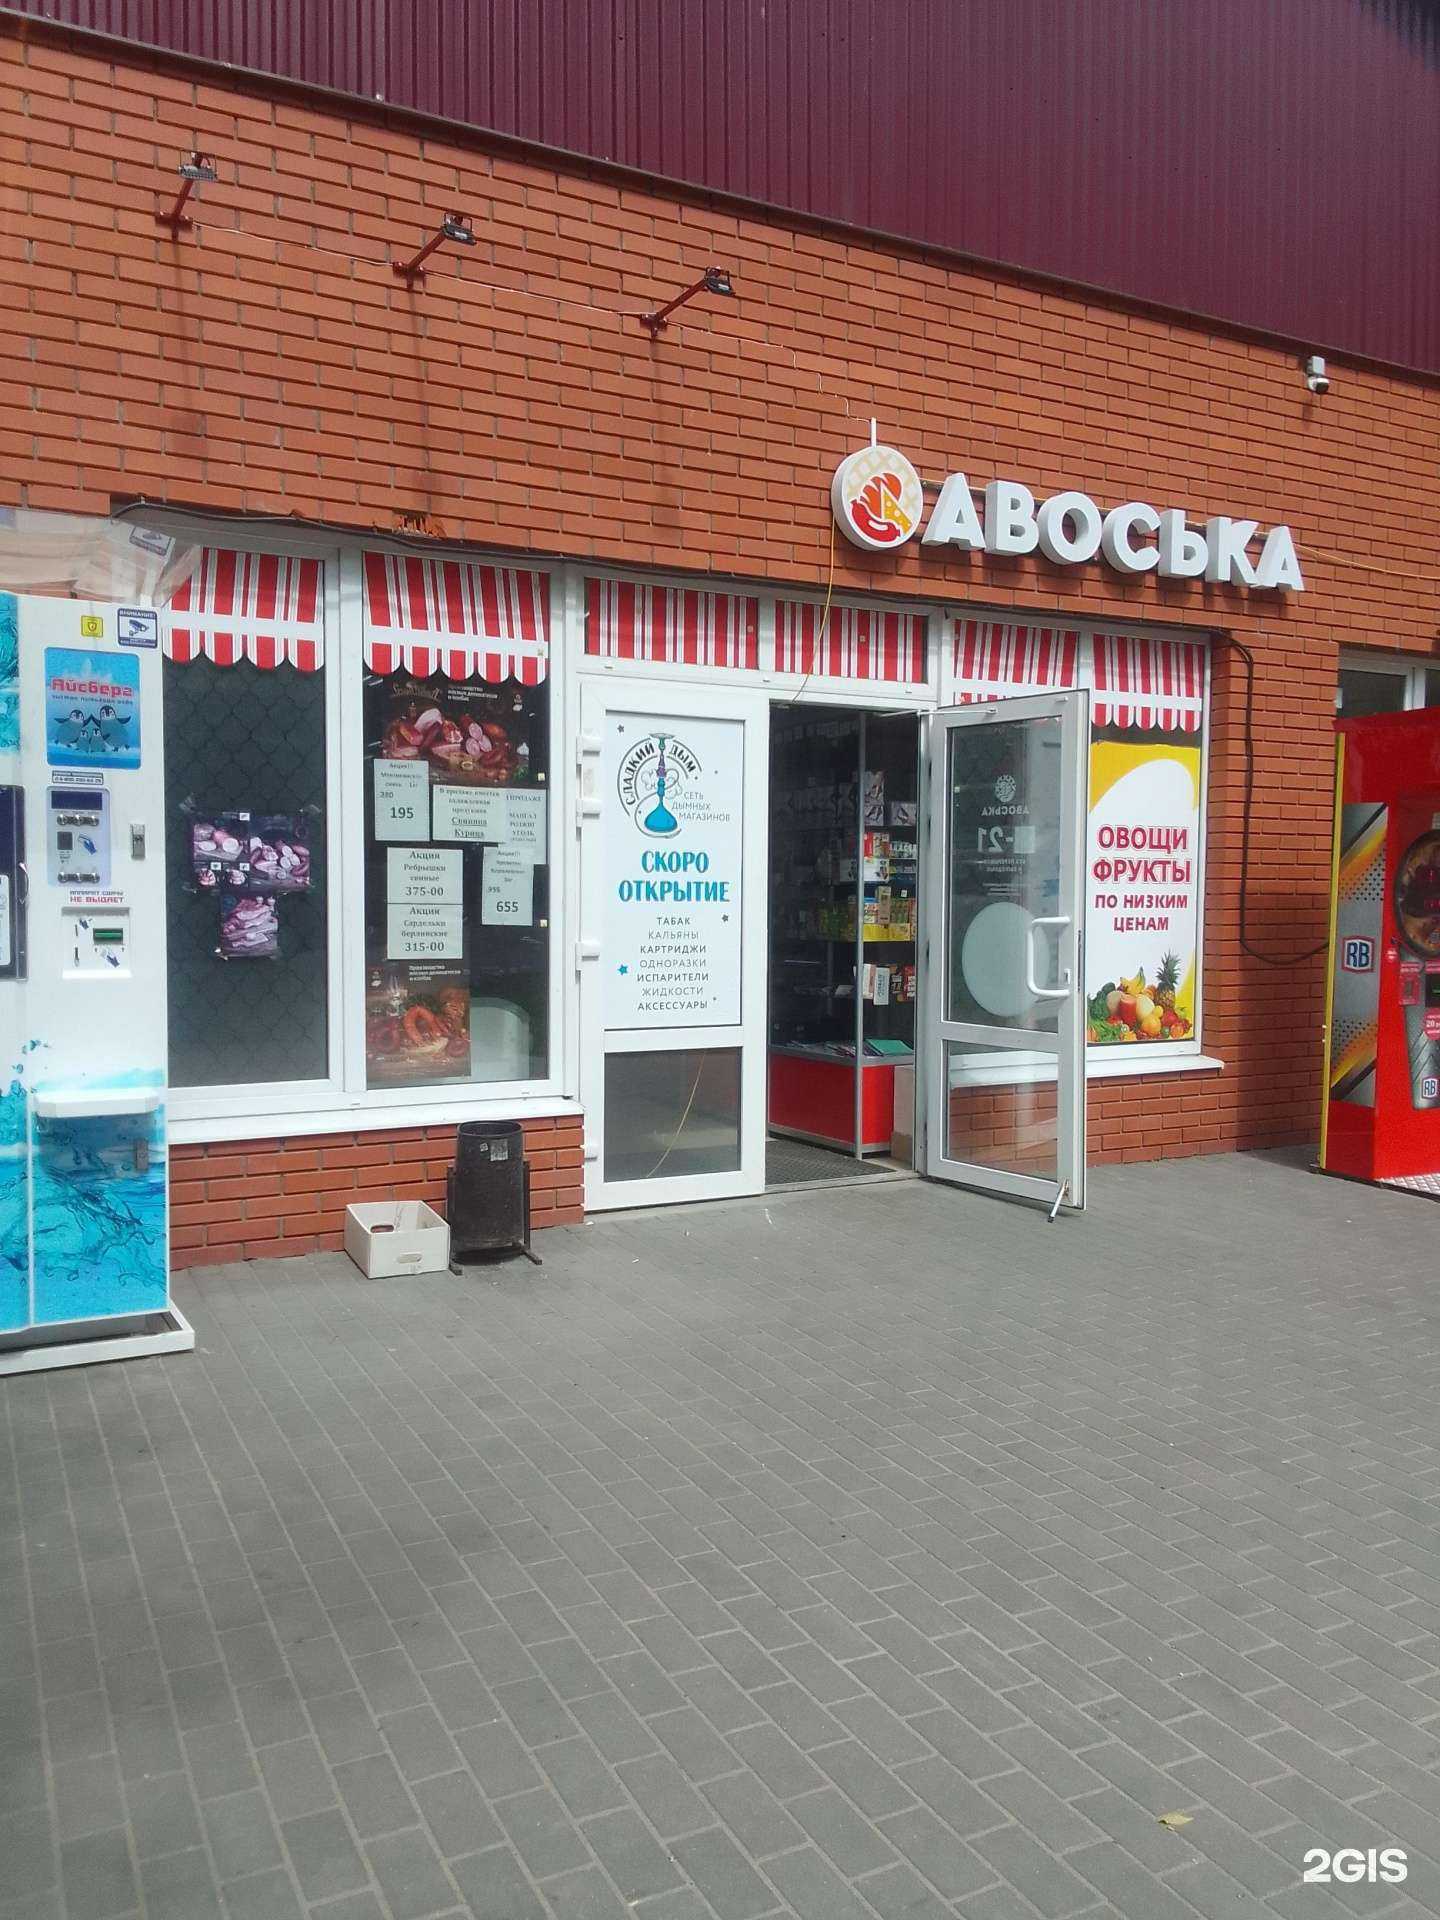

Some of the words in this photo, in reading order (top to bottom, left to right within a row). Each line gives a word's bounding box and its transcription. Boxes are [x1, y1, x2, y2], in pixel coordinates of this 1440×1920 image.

[921, 472, 1304, 592] АВОСЬКА
[669, 744, 697, 773] ДЫМ
[623, 741, 655, 805] СЛАДКИЙ
[684, 792, 704, 800] СЕТЬ
[672, 802, 711, 810] ДЫМНЫХ
[390, 806, 414, 819] 195
[679, 812, 731, 822] МАГАЗИНОВ
[454, 828, 485, 838] Курица
[1097, 825, 1188, 854] ОВОЩИ
[409, 850, 440, 860] Акция
[403, 863, 446, 871] Ребрышки
[641, 850, 710, 873] СКОРО
[1092, 858, 1192, 883] ФРУКТЫ
[405, 886, 444, 896] 375-00
[618, 880, 731, 902] ОТКРЫТИЕ
[496, 901, 519, 913] 655
[1095, 894, 1118, 909] ПО
[1123, 894, 1188, 909] НИЗКИМ
[409, 906, 440, 915] Акция
[656, 917, 691, 926] ТАБАК
[1113, 917, 1169, 933] ЦЕНАМ
[648, 930, 699, 940] КАЛЬЯНЫ
[405, 941, 445, 952] 315-00
[640, 945, 706, 954] КАРТРИДЖИ
[1346, 942, 1370, 968] RB
[639, 959, 706, 969] ОДНОРАЗКИ
[637, 973, 709, 982] ИСПАРИТЕЛИ
[641, 987, 704, 997] ЖИДКОСТИ
[637, 1000, 708, 1011] АКСЕССУАРЫ
[1424, 1080, 1436, 1097] RB
